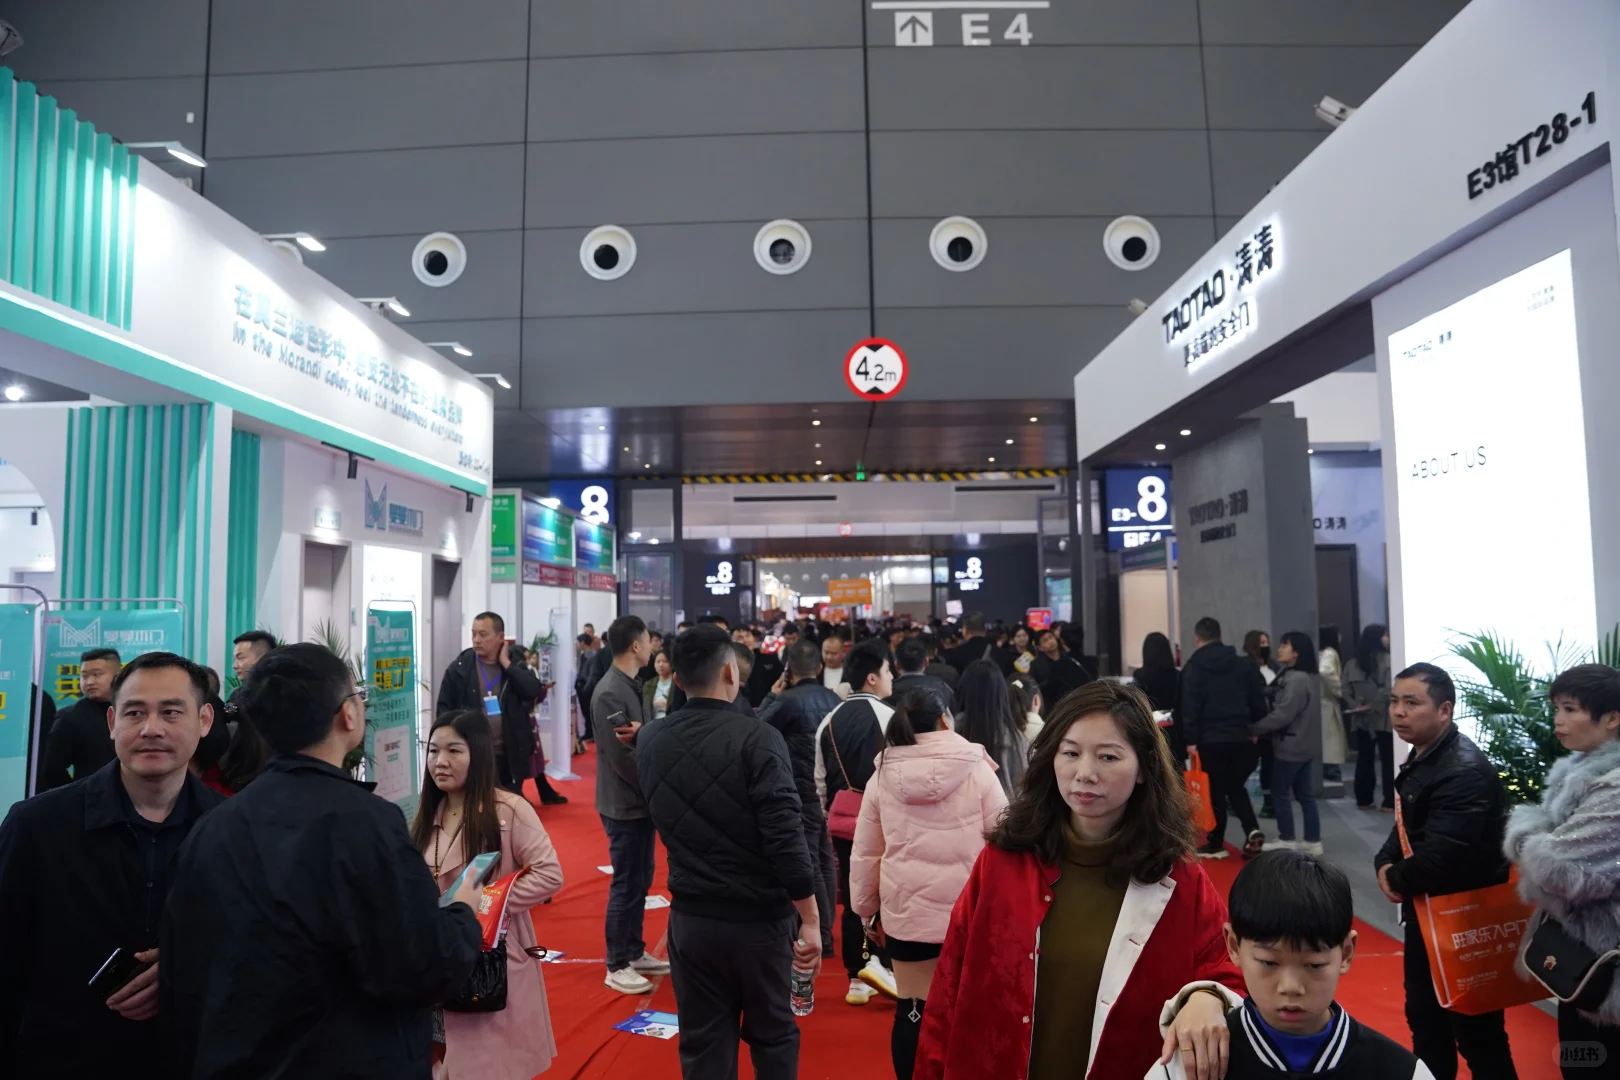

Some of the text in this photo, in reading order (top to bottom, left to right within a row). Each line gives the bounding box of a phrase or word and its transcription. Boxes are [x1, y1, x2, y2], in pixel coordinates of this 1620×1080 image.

[1467, 90, 1597, 200] E3馆T28-1
[252, 331, 273, 358] the
[278, 342, 322, 380] Morandi
[855, 355, 897, 382] 4.2m
[1411, 445, 1487, 480] ABOUT US
